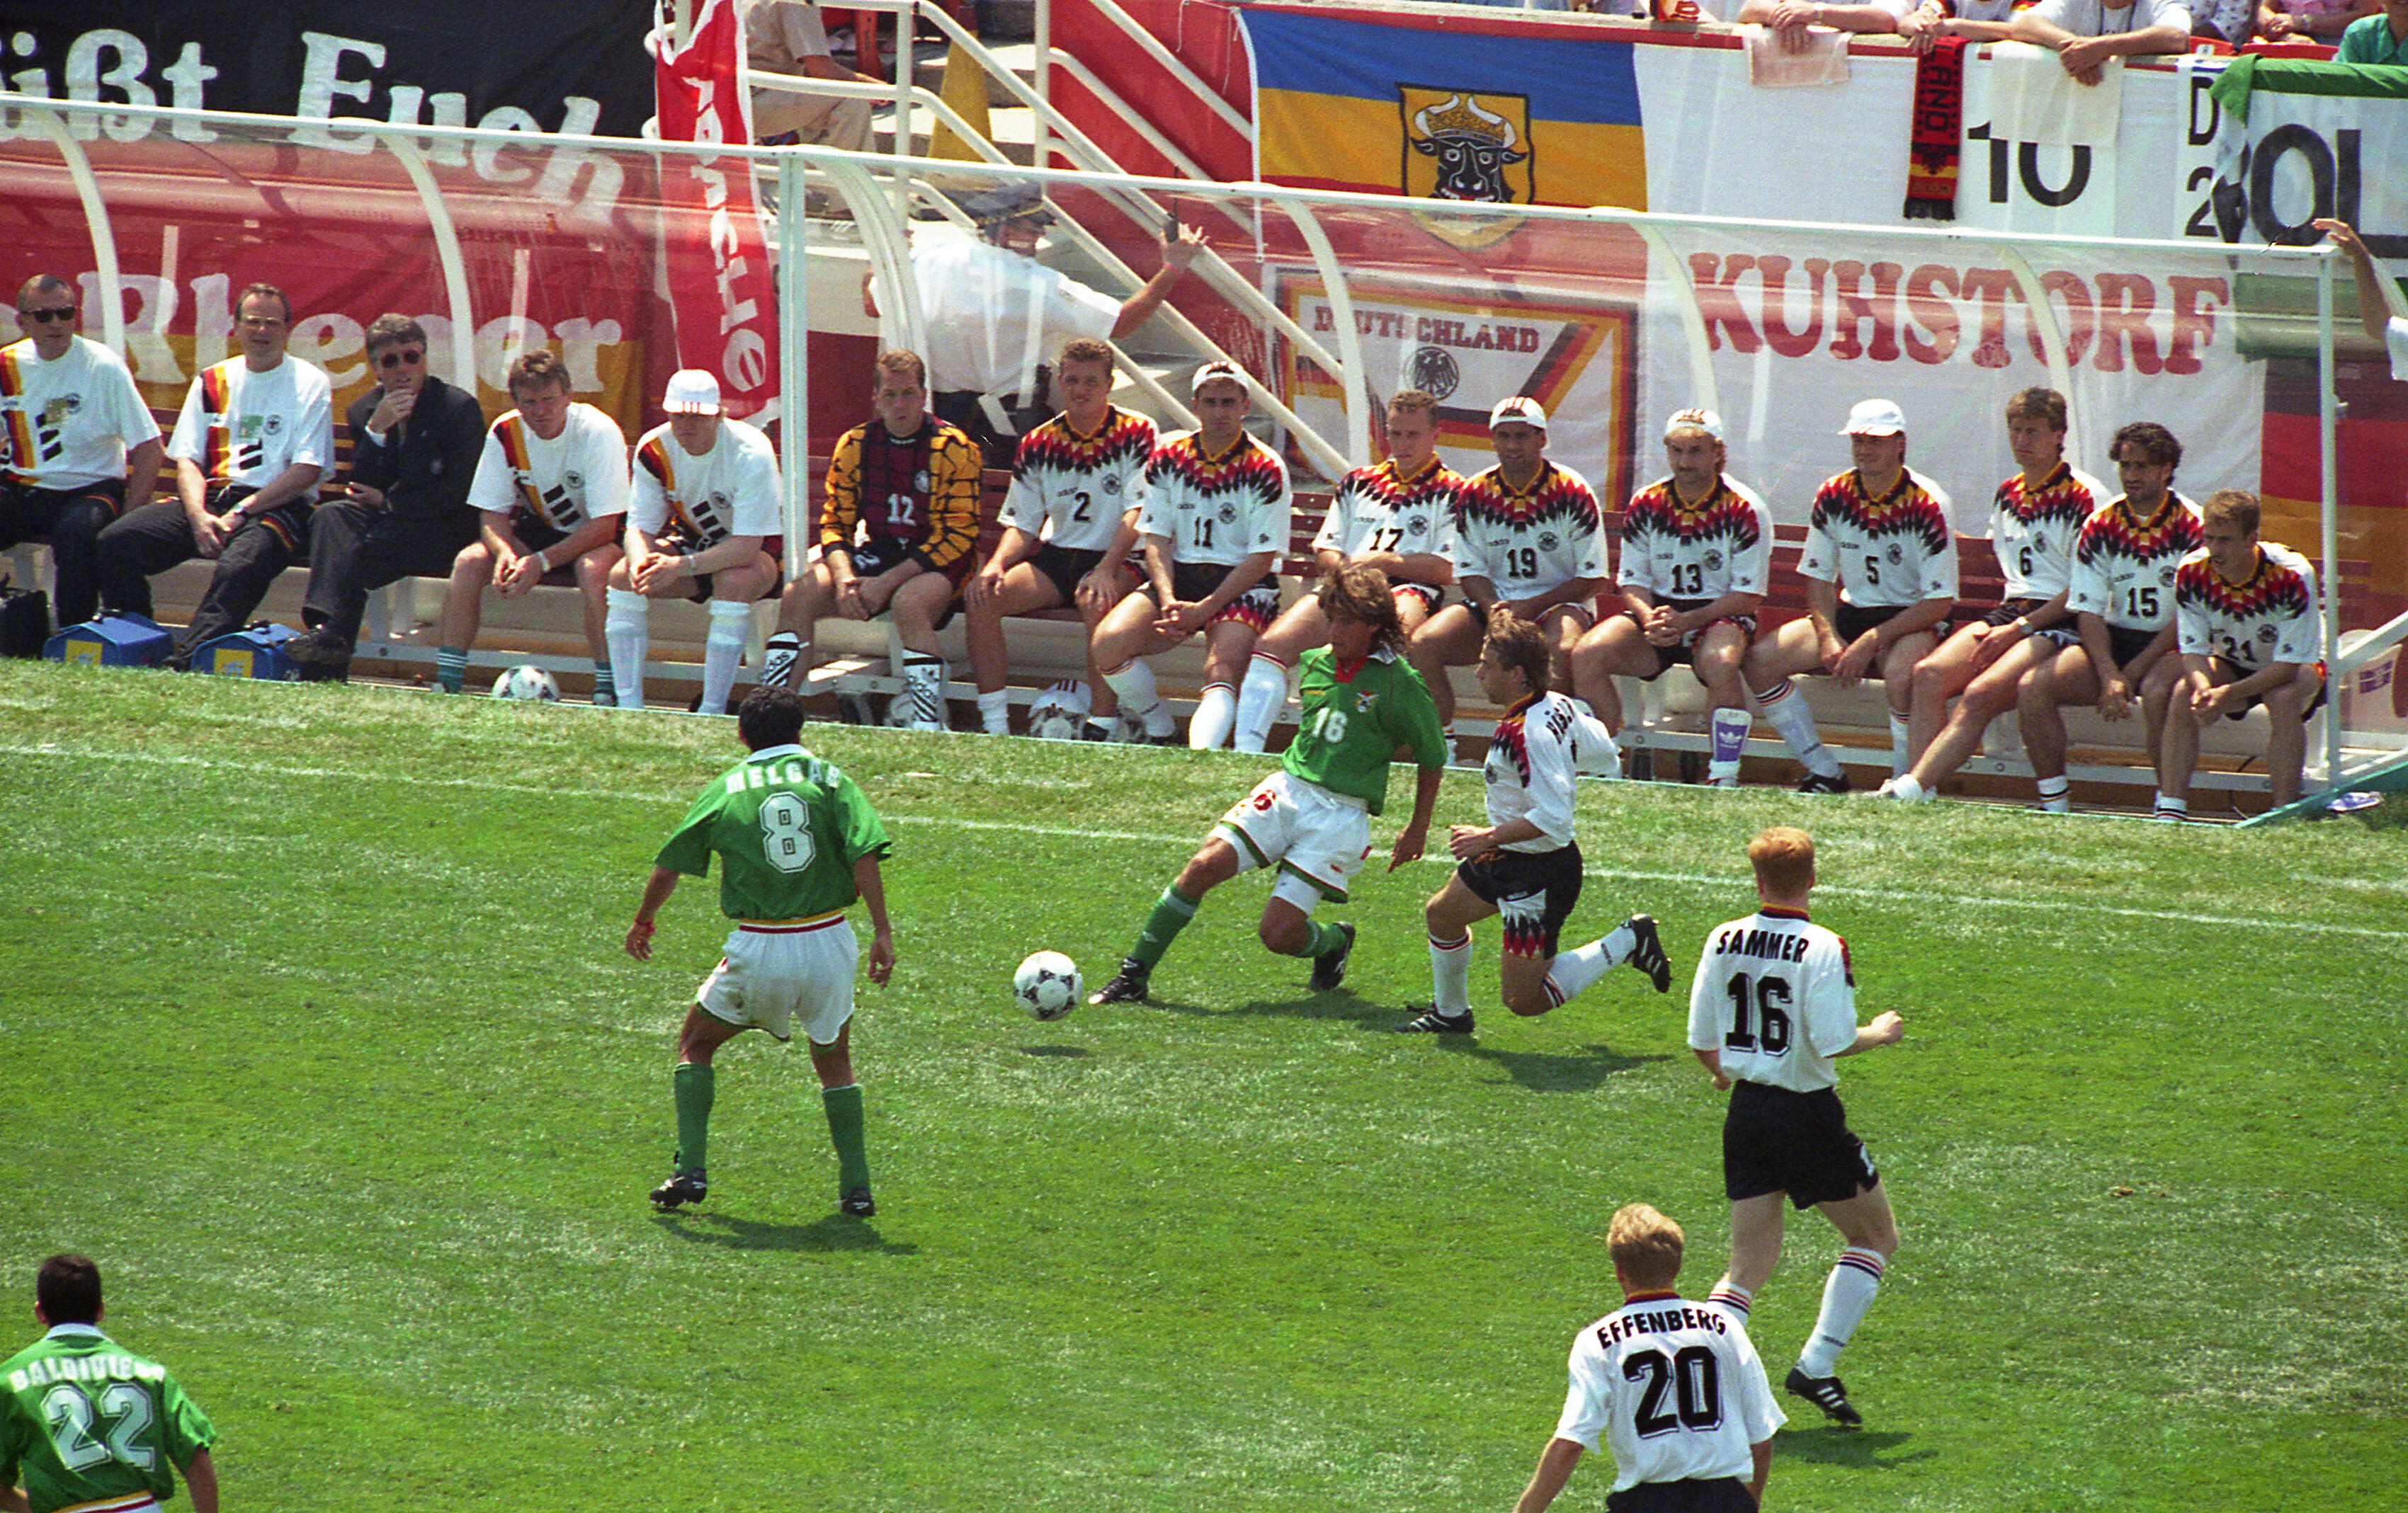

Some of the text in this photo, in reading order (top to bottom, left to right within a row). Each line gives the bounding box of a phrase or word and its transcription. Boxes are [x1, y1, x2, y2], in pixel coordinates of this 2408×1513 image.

[287, 31, 625, 224] Euch
[1314, 305, 1540, 353] DUTSCHLAND
[1688, 252, 2229, 375] KUHSTORF
[887, 493, 917, 527] 12
[1074, 491, 1091, 523] 2
[1194, 516, 1214, 551] 11
[1368, 527, 1404, 553] 17
[1506, 547, 1539, 579] 19
[1865, 555, 1880, 586] 5
[2019, 545, 2033, 577] 6
[1671, 563, 1703, 595] 13
[2127, 586, 2159, 618] 15
[2222, 636, 2259, 663] 21
[1312, 707, 1348, 744] 16
[759, 791, 817, 874] 8
[1716, 928, 1810, 964] SAMMER
[1725, 971, 1794, 1058] 16
[1596, 1308, 1727, 1350] EFFENBERG
[1622, 1345, 1725, 1440] 20
[40, 1382, 155, 1473] 22
